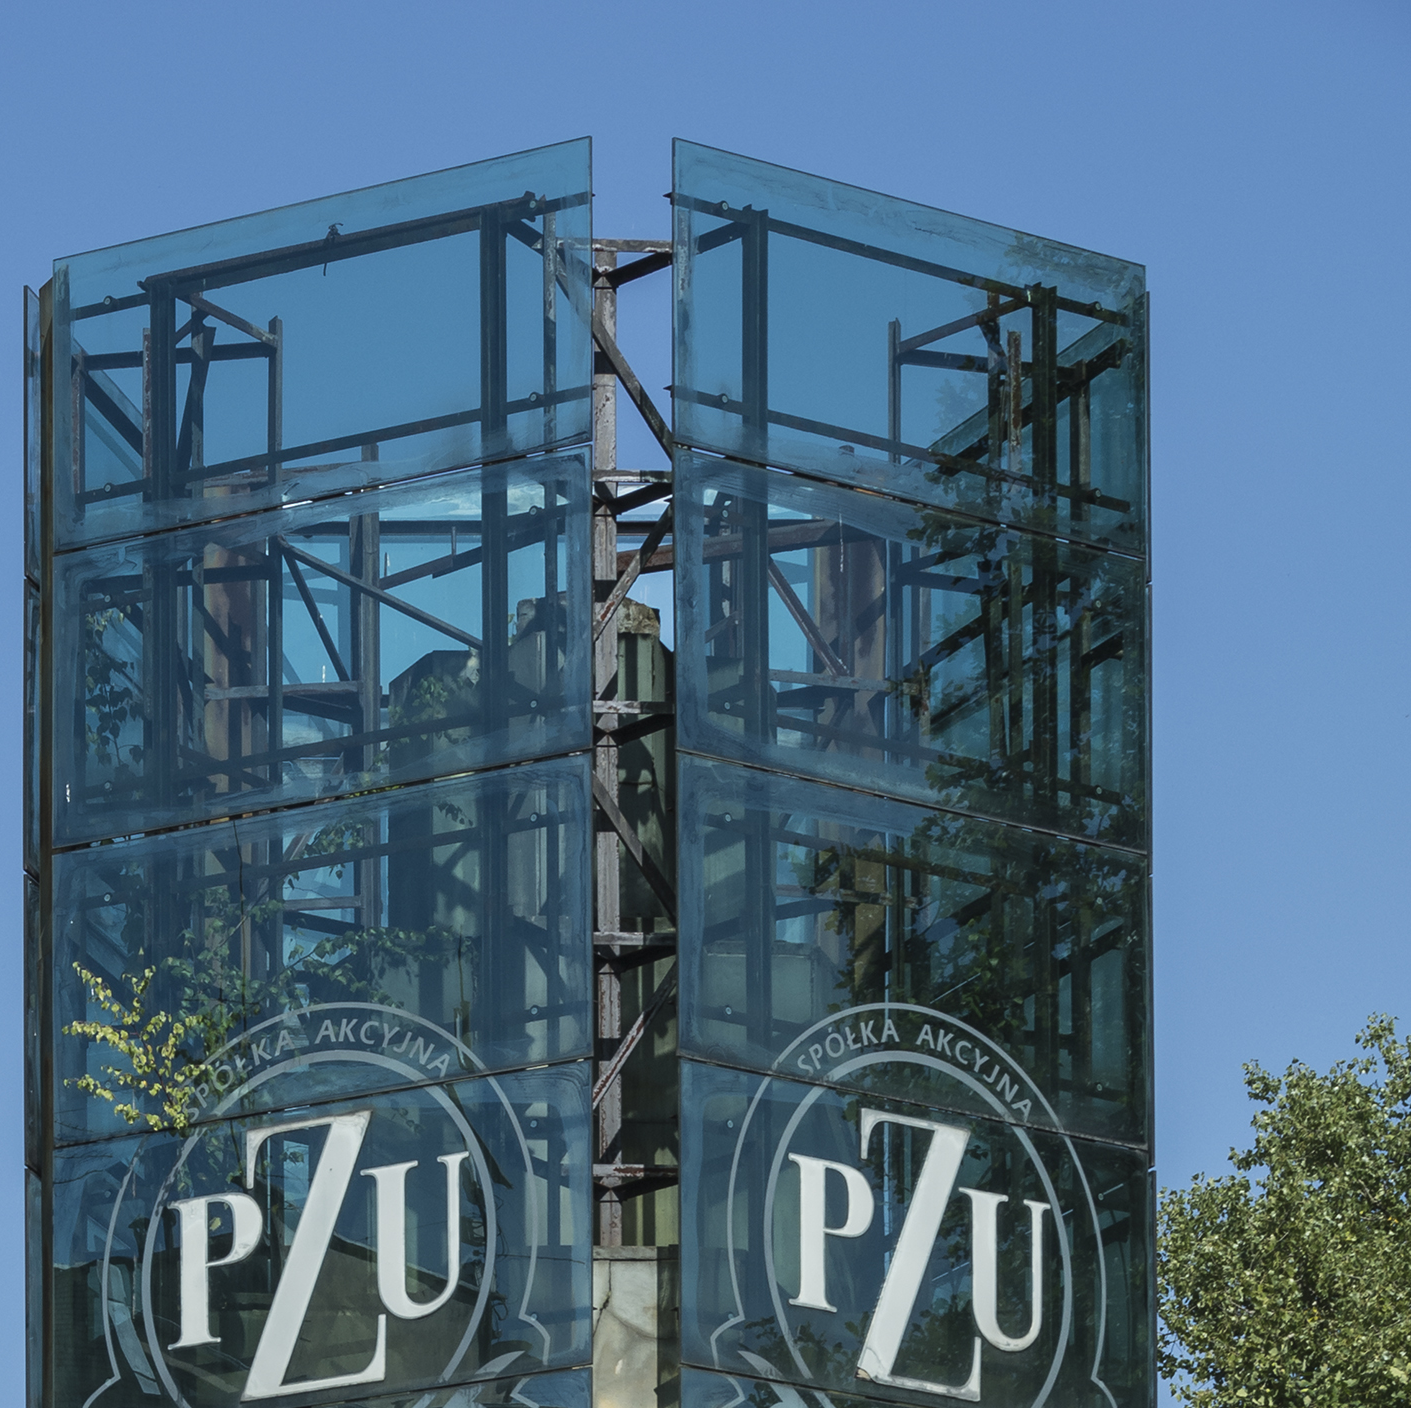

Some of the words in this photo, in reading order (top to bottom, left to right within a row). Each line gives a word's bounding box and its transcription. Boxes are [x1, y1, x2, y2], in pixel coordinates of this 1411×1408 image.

[315, 1018, 451, 1077] AKCYJNA
[797, 1019, 900, 1076] SPÓŁKA
[916, 1024, 1032, 1122] AKCYJNA
[167, 1109, 469, 1401] PZU
[788, 1107, 1051, 1401] PZU
